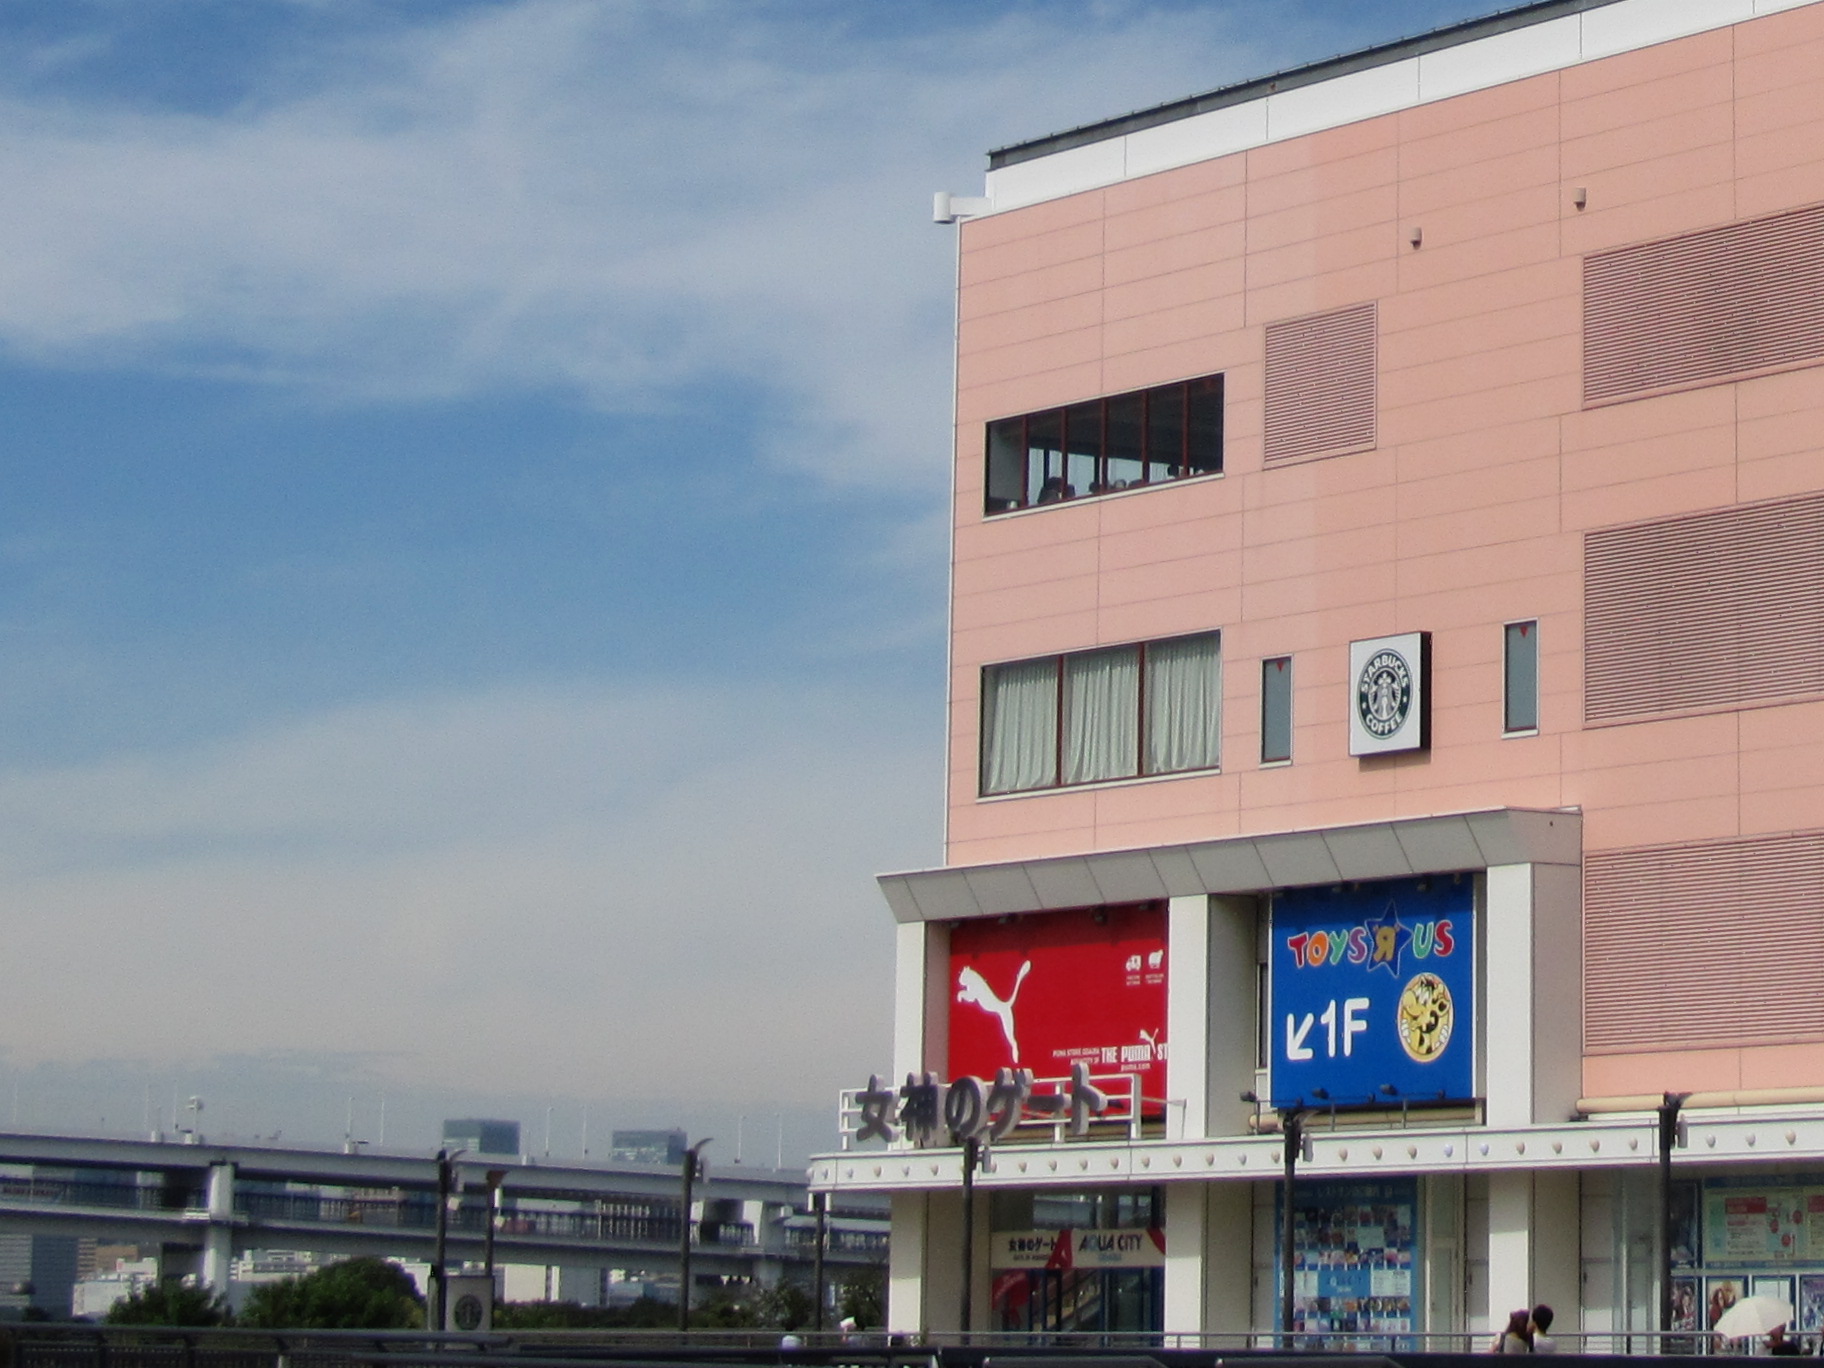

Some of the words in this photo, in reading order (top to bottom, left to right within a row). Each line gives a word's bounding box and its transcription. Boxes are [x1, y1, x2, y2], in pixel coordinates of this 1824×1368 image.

[1361, 655, 1409, 693] STARBUCKS
[1366, 711, 1403, 734] COFFEE
[1288, 926, 1367, 968] TOYS
[1413, 920, 1454, 959] US
[1321, 998, 1370, 1057] 1F
[1101, 1046, 1117, 1063] THE
[1121, 1045, 1151, 1063] PUMA
[856, 1062, 1108, 1142] 女神のゲート
